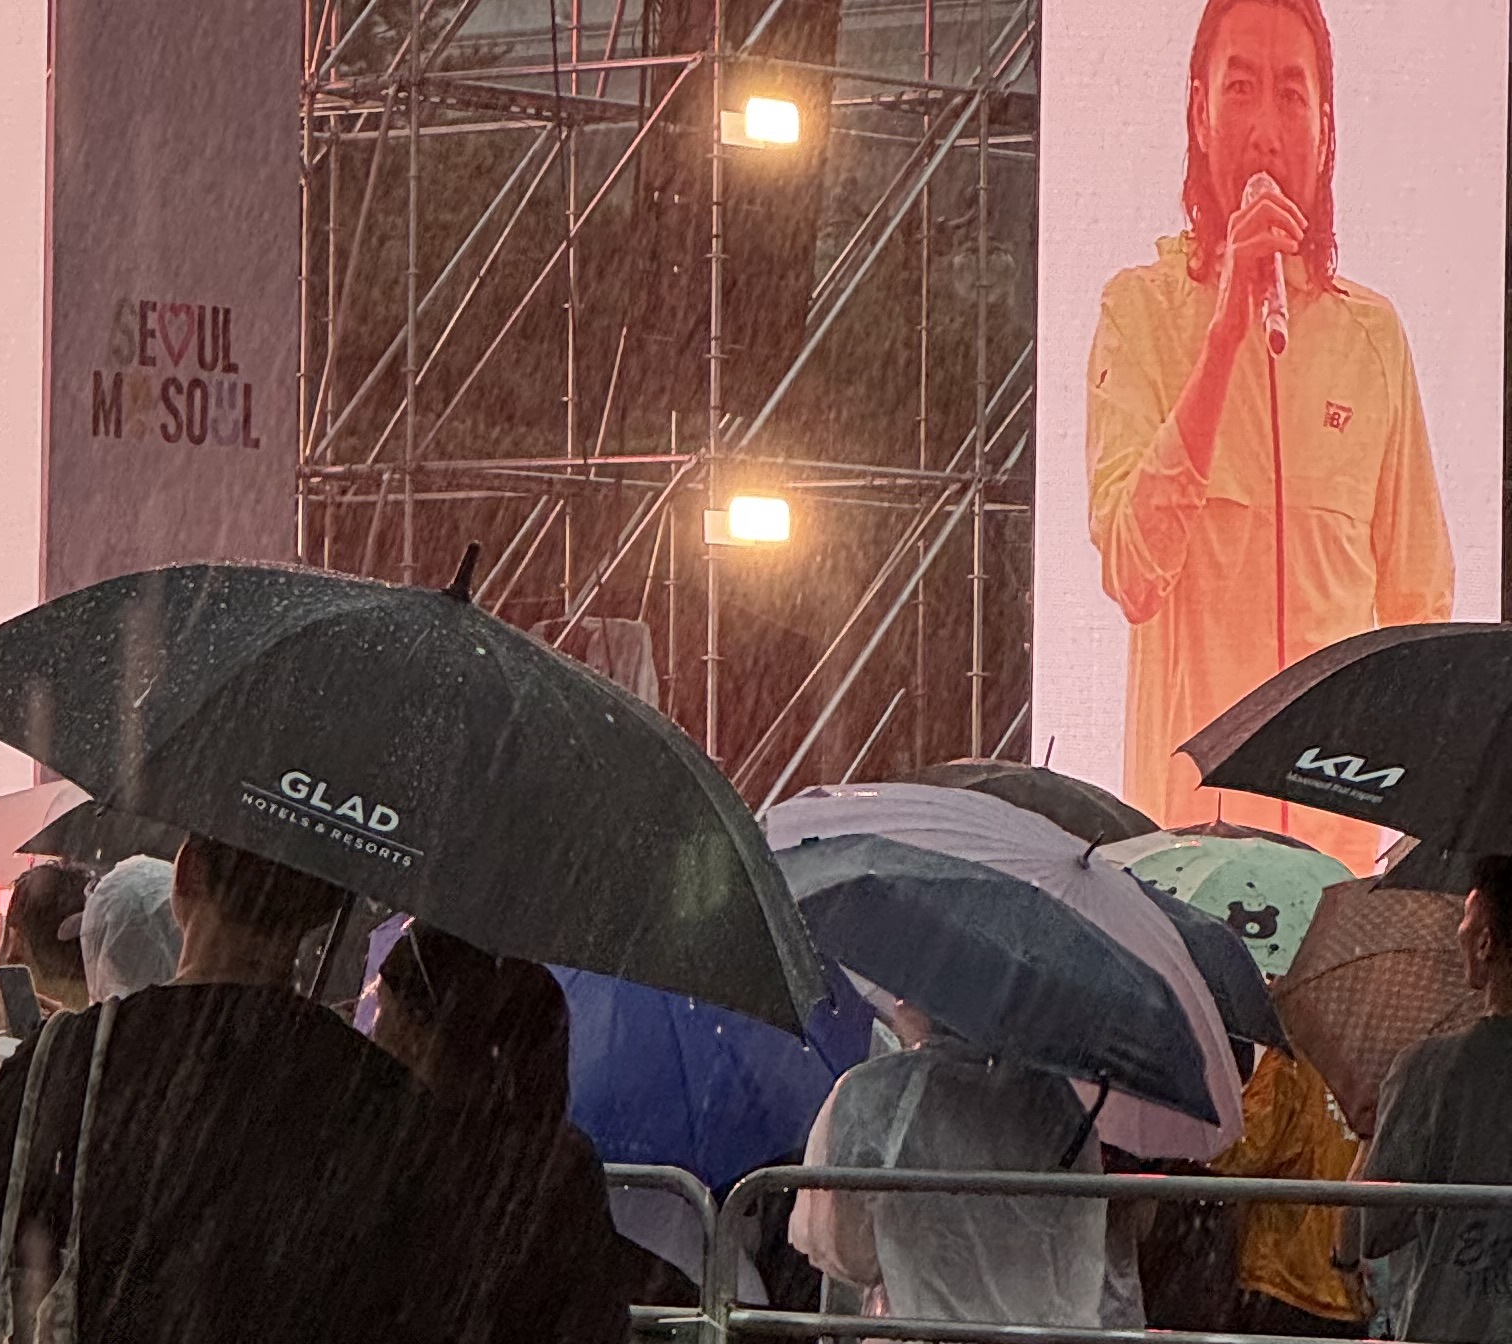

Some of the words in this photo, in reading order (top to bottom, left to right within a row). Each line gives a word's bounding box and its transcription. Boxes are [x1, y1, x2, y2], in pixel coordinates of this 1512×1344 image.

[241, 792, 310, 828] HOTELS
[314, 821, 326, 834] &
[329, 827, 413, 867] RESORTS
[279, 770, 400, 832] GLAD
